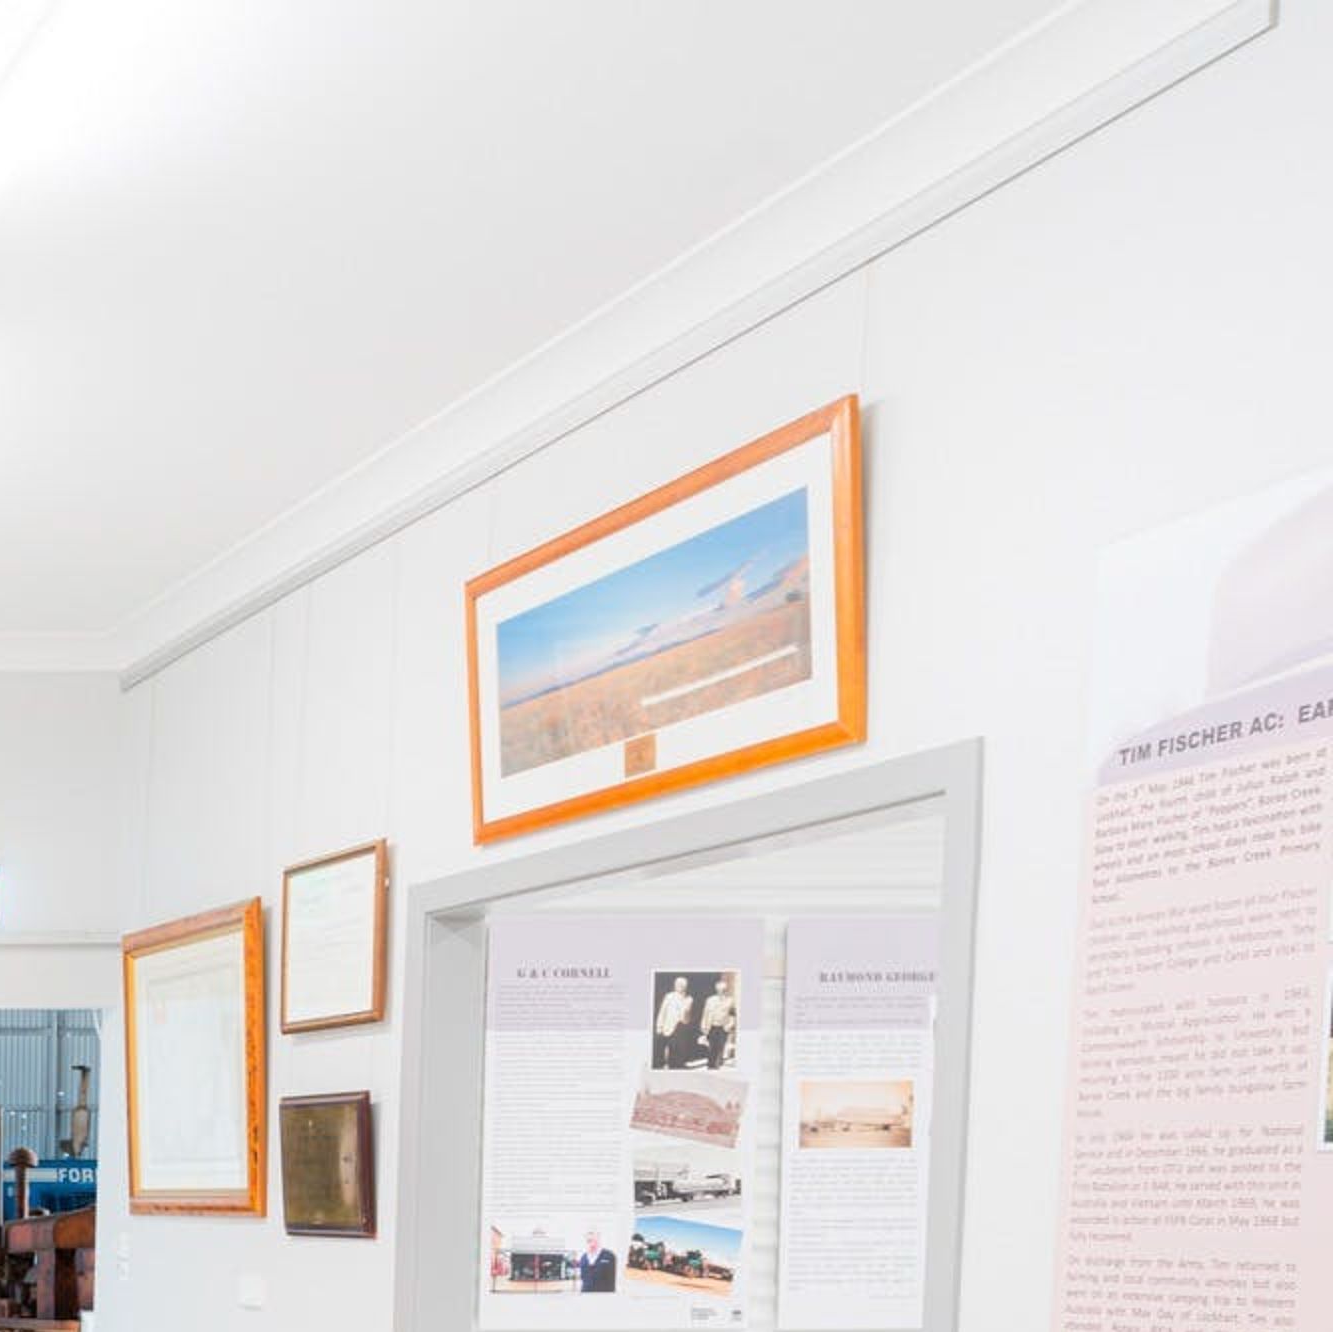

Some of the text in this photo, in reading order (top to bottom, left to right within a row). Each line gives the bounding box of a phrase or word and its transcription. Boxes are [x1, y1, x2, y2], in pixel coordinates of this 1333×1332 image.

[1119, 743, 1152, 766] TIM
[1158, 720, 1243, 757] FISCHER
[1249, 712, 1284, 736] AC:
[58, 1166, 97, 1183] FOR
